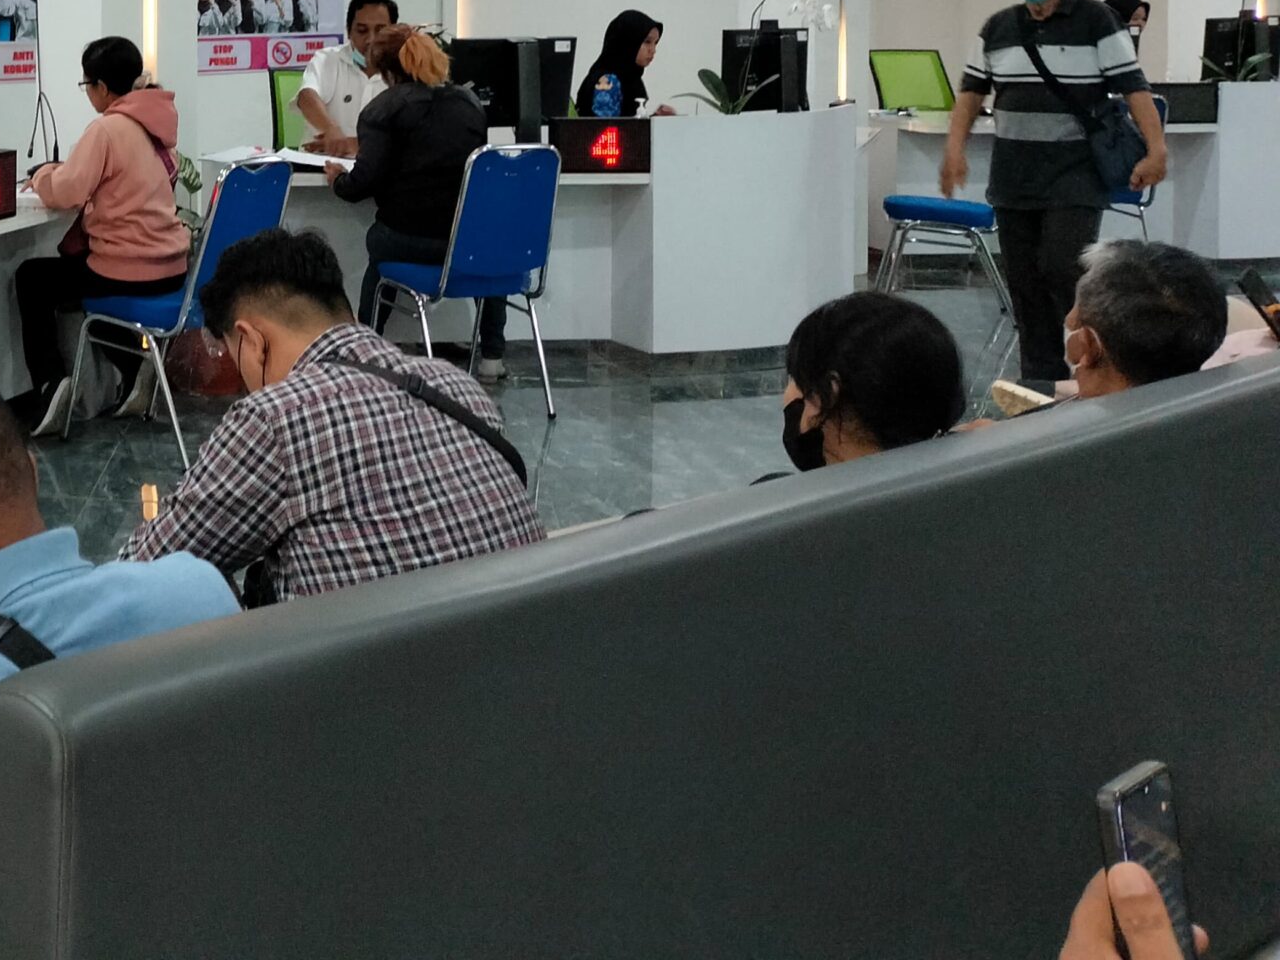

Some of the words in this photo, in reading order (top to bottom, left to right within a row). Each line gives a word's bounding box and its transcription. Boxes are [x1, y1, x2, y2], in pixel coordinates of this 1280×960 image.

[213, 45, 234, 54] STOP
[13, 51, 34, 61] ANTI
[591, 127, 620, 167] 4
